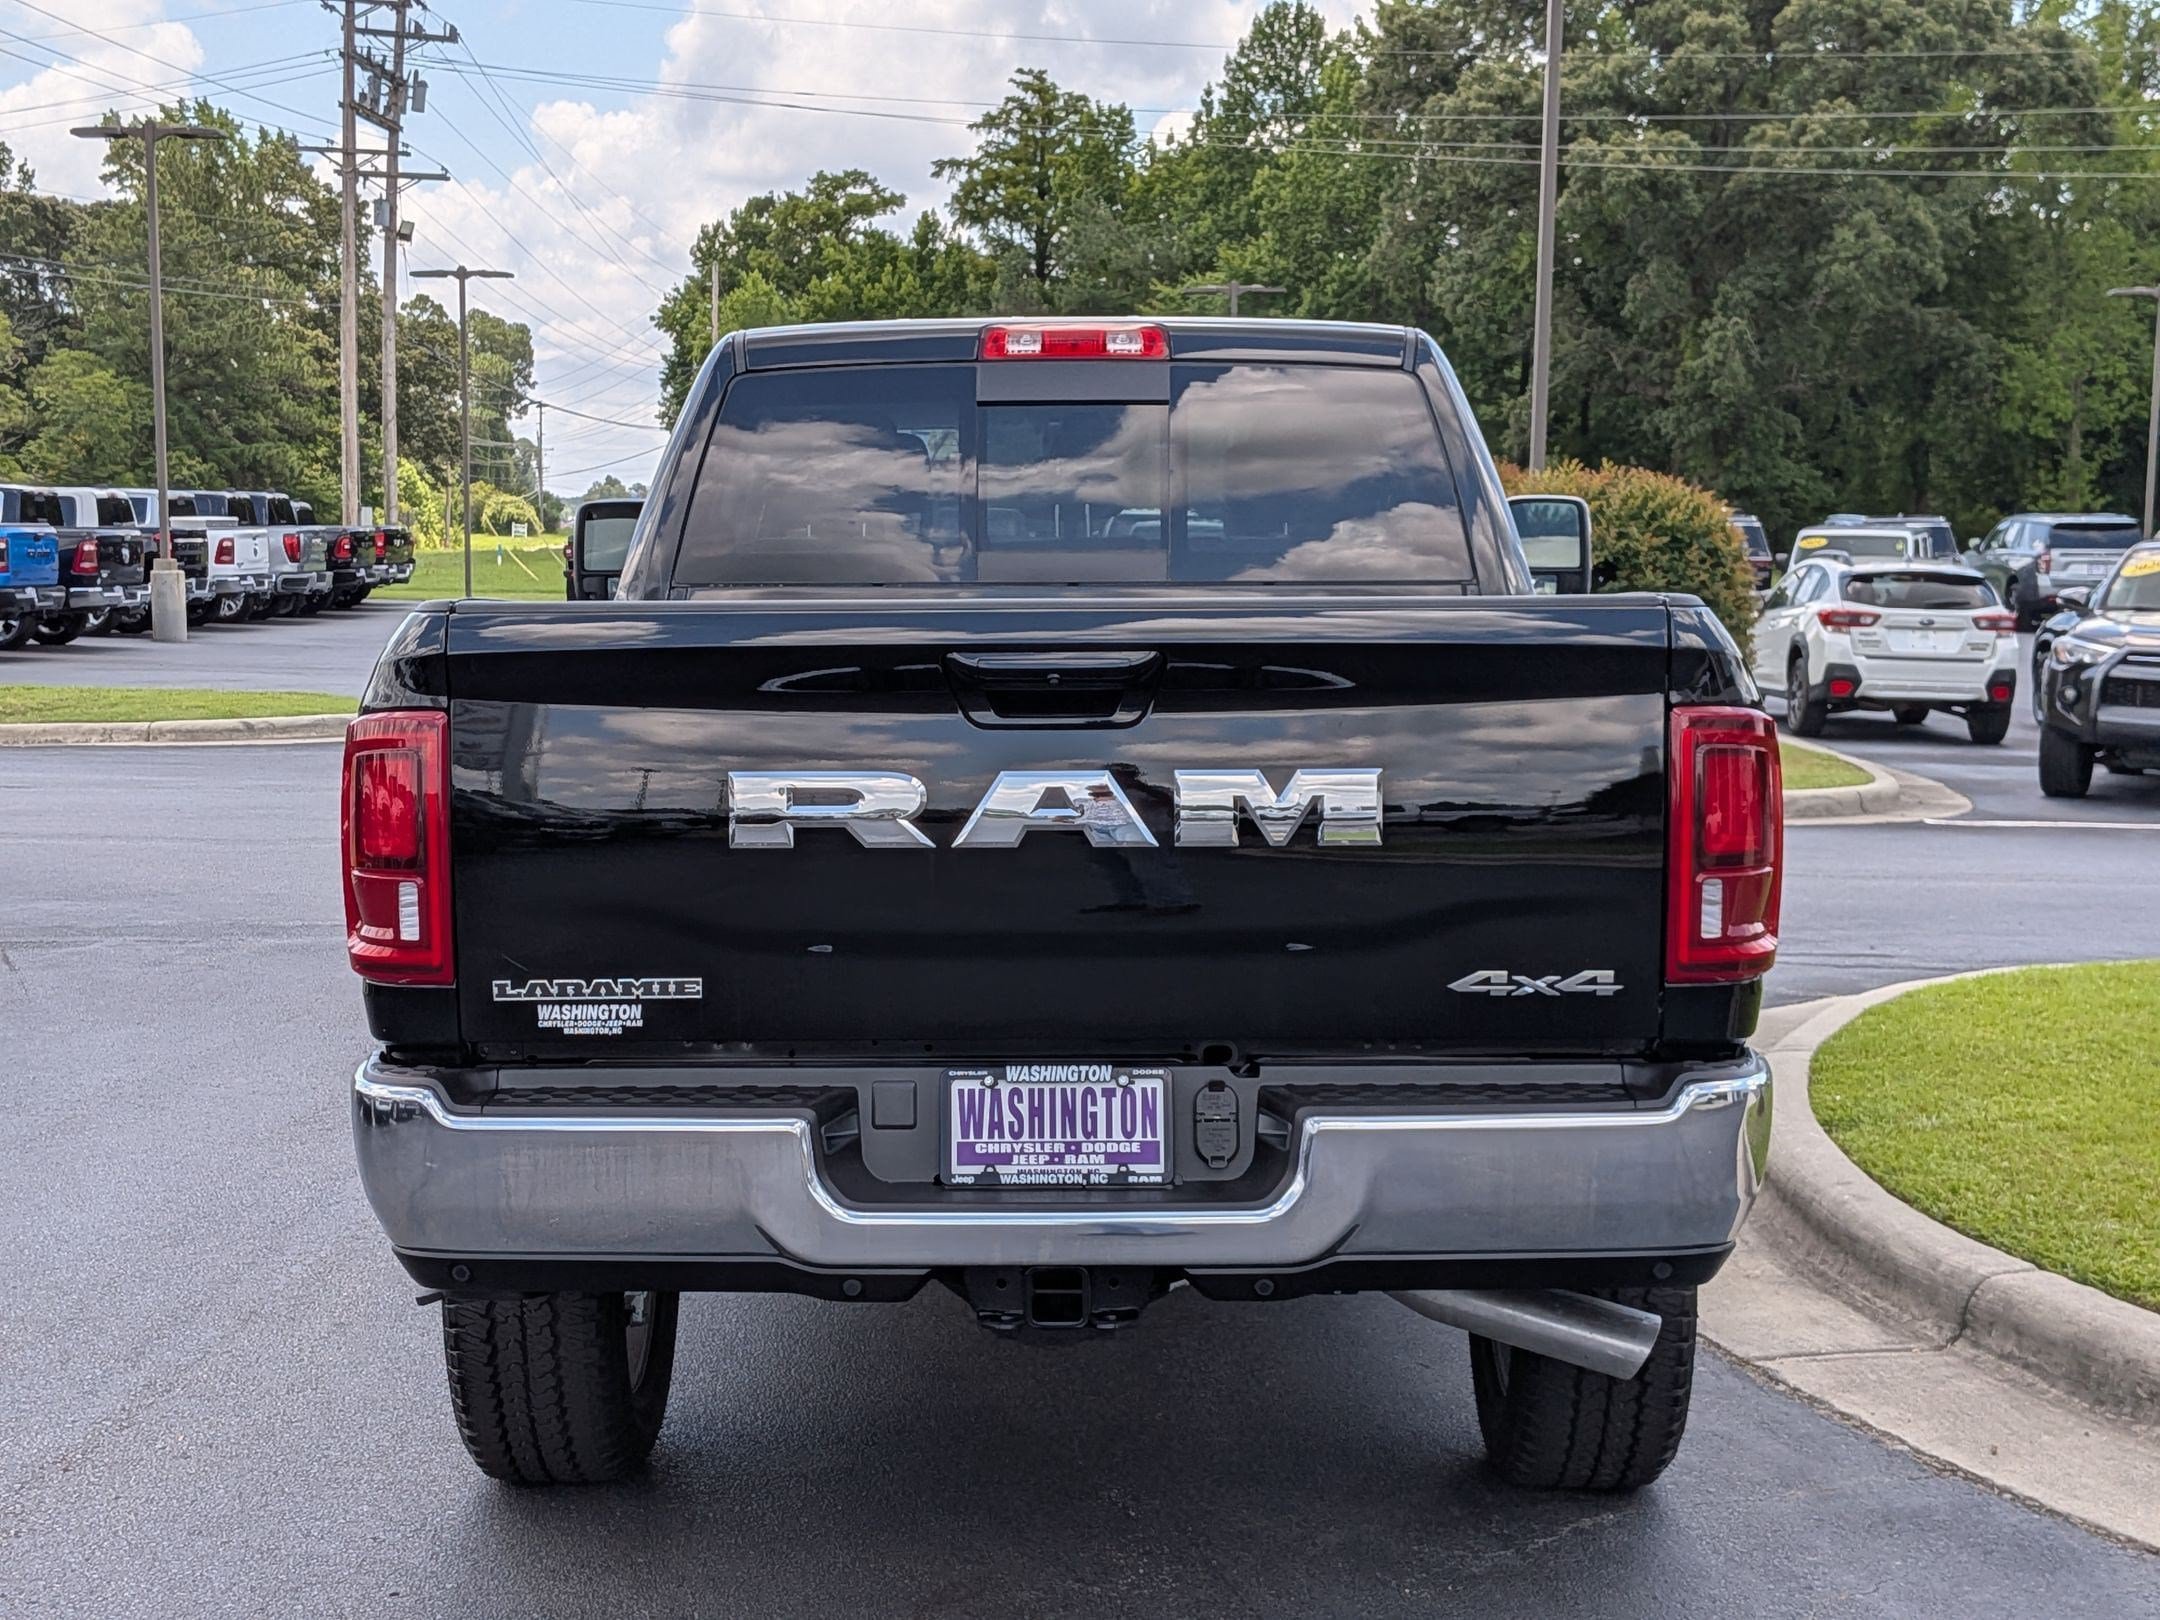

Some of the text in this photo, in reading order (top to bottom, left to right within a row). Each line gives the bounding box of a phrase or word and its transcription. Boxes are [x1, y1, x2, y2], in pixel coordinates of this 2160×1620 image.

[727, 768, 1384, 849] RAM
[492, 977, 703, 1001] LARAMIE
[1447, 970, 1625, 996] 4x4
[537, 1004, 642, 1020] WASHINGTON
[1005, 1065, 1112, 1082] WASHINGTON
[957, 1086, 1158, 1140] WASHINGTON
[975, 1142, 1141, 1153] CHRYSLER DODGE
[1011, 1154, 1105, 1165] JEEP RAM
[951, 1174, 975, 1185] Jeep
[1000, 1173, 1109, 1186] WASHINGTON, NC
[1128, 1175, 1163, 1183] RAM
